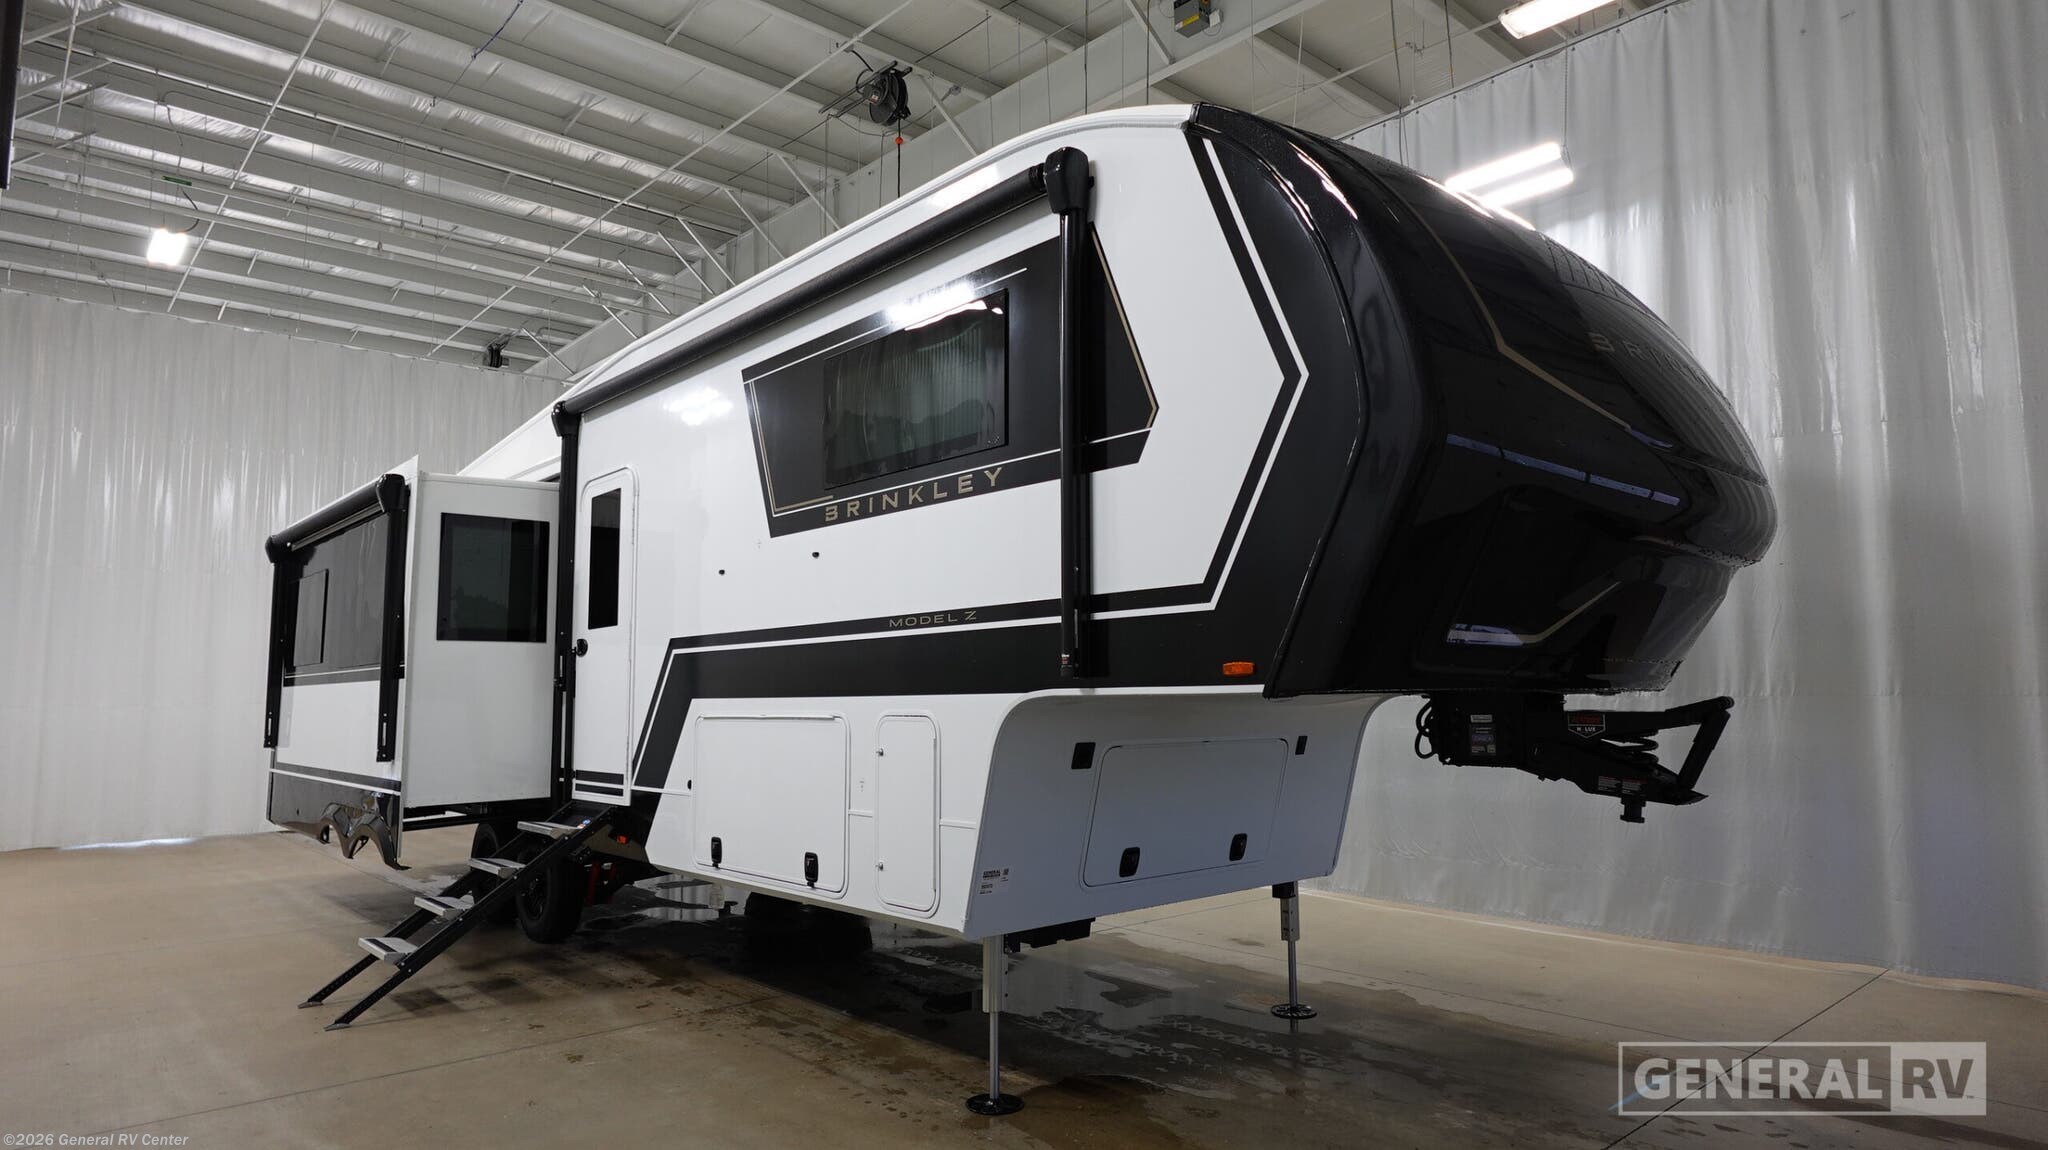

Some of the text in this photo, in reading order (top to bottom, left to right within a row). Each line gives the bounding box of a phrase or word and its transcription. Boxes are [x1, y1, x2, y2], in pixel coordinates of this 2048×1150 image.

[825, 467, 1002, 522] BRINKLEY
[889, 610, 977, 628] MODEL Z
